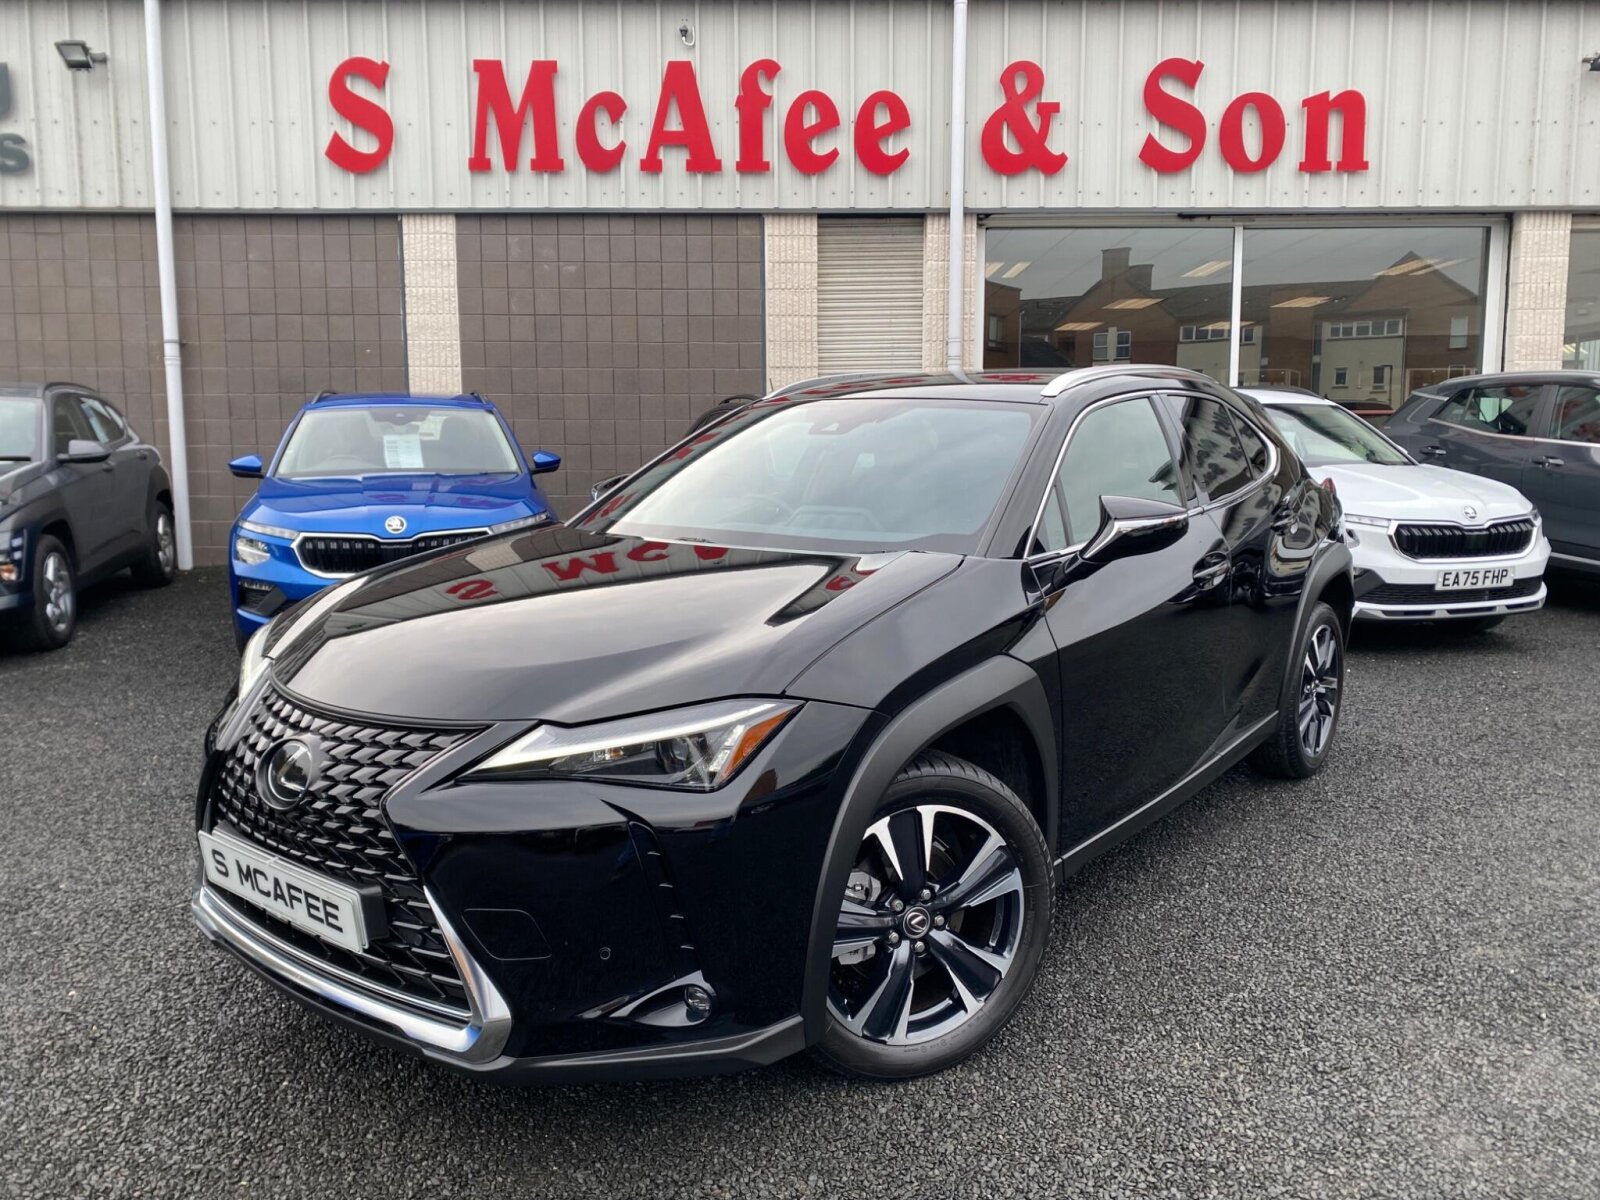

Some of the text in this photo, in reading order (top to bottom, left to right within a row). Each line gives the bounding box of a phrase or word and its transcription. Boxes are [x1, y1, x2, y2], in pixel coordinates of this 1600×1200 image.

[326, 57, 1369, 175] S McAfee & Son
[1442, 568, 1508, 587] EA75 FHP
[212, 849, 343, 933] S MCAFEE
